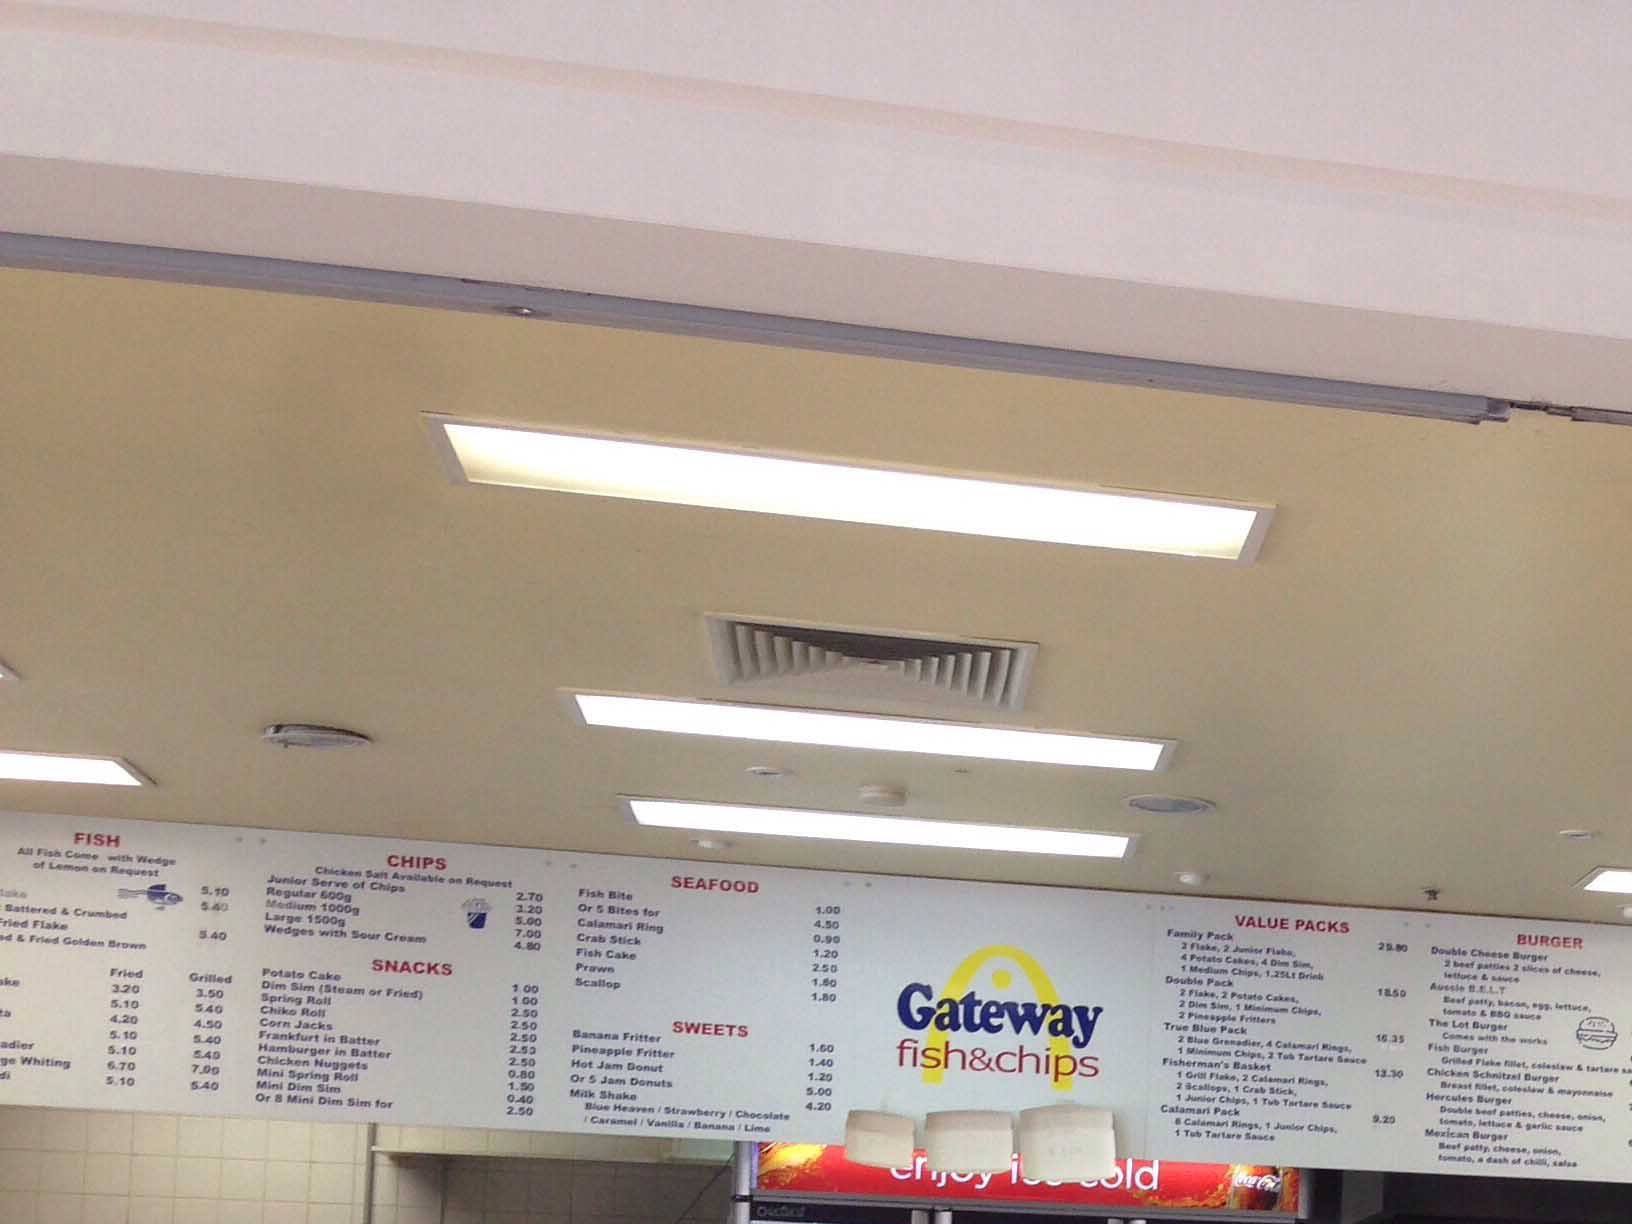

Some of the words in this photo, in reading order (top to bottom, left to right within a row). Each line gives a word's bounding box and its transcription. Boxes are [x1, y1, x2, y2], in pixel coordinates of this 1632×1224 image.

[73, 833, 120, 847] FISH
[17, 847, 33, 856] All
[36, 848, 61, 858] Fish
[64, 851, 99, 860] Come
[107, 854, 133, 863] with
[136, 856, 176, 866] Wedge
[387, 855, 446, 870] CHIPS
[32, 861, 45, 870] of
[48, 863, 89, 872] Lemon
[109, 867, 159, 877] Request
[267, 876, 306, 886] Junior
[311, 879, 348, 889] Serve
[352, 881, 365, 890] of
[369, 882, 405, 893] Chips
[671, 877, 759, 893] SEAFOOD
[266, 887, 316, 899] Regular
[578, 889, 604, 899] Fish
[608, 891, 633, 901] Bite
[4, 905, 57, 915] Battered
[60, 907, 69, 916] &
[73, 909, 127, 919] Crumbed
[265, 914, 302, 924] Large
[307, 915, 346, 927] 1500g
[577, 919, 633, 930] Calamari
[635, 923, 664, 934] Ring
[1235, 916, 1289, 930] VALUE
[1295, 919, 1349, 934] PACKS
[264, 926, 314, 937] Wedges
[319, 929, 347, 938] with
[351, 931, 380, 941] Sour
[384, 933, 427, 944] Cream
[576, 934, 606, 943] Crab
[609, 936, 641, 946] Stick
[1167, 930, 1203, 939] Family
[1206, 932, 1233, 941] Pack
[1516, 934, 1583, 949] BURGER
[575, 948, 602, 958] Fish
[605, 951, 636, 960] Cake
[109, 968, 143, 978] Fried
[372, 960, 452, 975] SNACKS
[575, 964, 615, 973] Prawn
[188, 973, 232, 984] Grilled
[261, 969, 304, 979] Potato
[308, 971, 341, 981] Cake
[575, 978, 621, 989] Scallop
[1165, 976, 1203, 986] Double
[1206, 979, 1234, 988] Pack
[261, 994, 303, 1005] Spring
[306, 996, 331, 1006] Roll
[260, 1006, 297, 1016] Chiko
[300, 1008, 326, 1018] Roll
[897, 982, 1104, 1050] Gateway
[259, 1018, 291, 1028] Corn
[294, 1021, 333, 1031] Jacks
[672, 1021, 748, 1037] SWEETS
[1164, 1023, 1189, 1032] True
[1191, 1024, 1217, 1033] Blue
[1220, 1026, 1247, 1035] Pack
[1429, 1018, 1448, 1028] The
[1451, 1021, 1469, 1030] Lot
[1472, 1022, 1507, 1032] Burger
[258, 1031, 319, 1042] Frankfurt
[323, 1036, 336, 1044] in
[339, 1036, 379, 1046] Batter
[571, 1046, 632, 1057] Pineapple
[636, 1049, 674, 1058] Fritter
[1427, 1043, 1450, 1053] Fish
[1452, 1046, 1488, 1055] Burger
[20, 1057, 71, 1068] Whiting
[257, 1056, 310, 1067] Chicken
[314, 1060, 368, 1071] Nuggets
[570, 1060, 593, 1069] Hot
[597, 1062, 623, 1071] Jam
[626, 1063, 663, 1073] Donut
[896, 1038, 1100, 1082] fish&chips
[256, 1068, 284, 1078] Mini
[288, 1071, 330, 1082] Spring
[333, 1072, 359, 1082] Roll
[1426, 1068, 1469, 1078] Chicken
[1472, 1071, 1521, 1081] Schnitzel
[1523, 1074, 1558, 1083] Burger
[569, 1089, 595, 1099] Milk
[599, 1091, 637, 1101] Shake
[1425, 1094, 1473, 1103] Hercules
[1476, 1096, 1512, 1105] Burger
[1160, 1105, 1210, 1115] Calamari
[1213, 1107, 1240, 1117] Pack
[1424, 1130, 1470, 1139] Mexican
[1472, 1132, 1507, 1141] Burger
[1080, 1158, 1160, 1191] old
